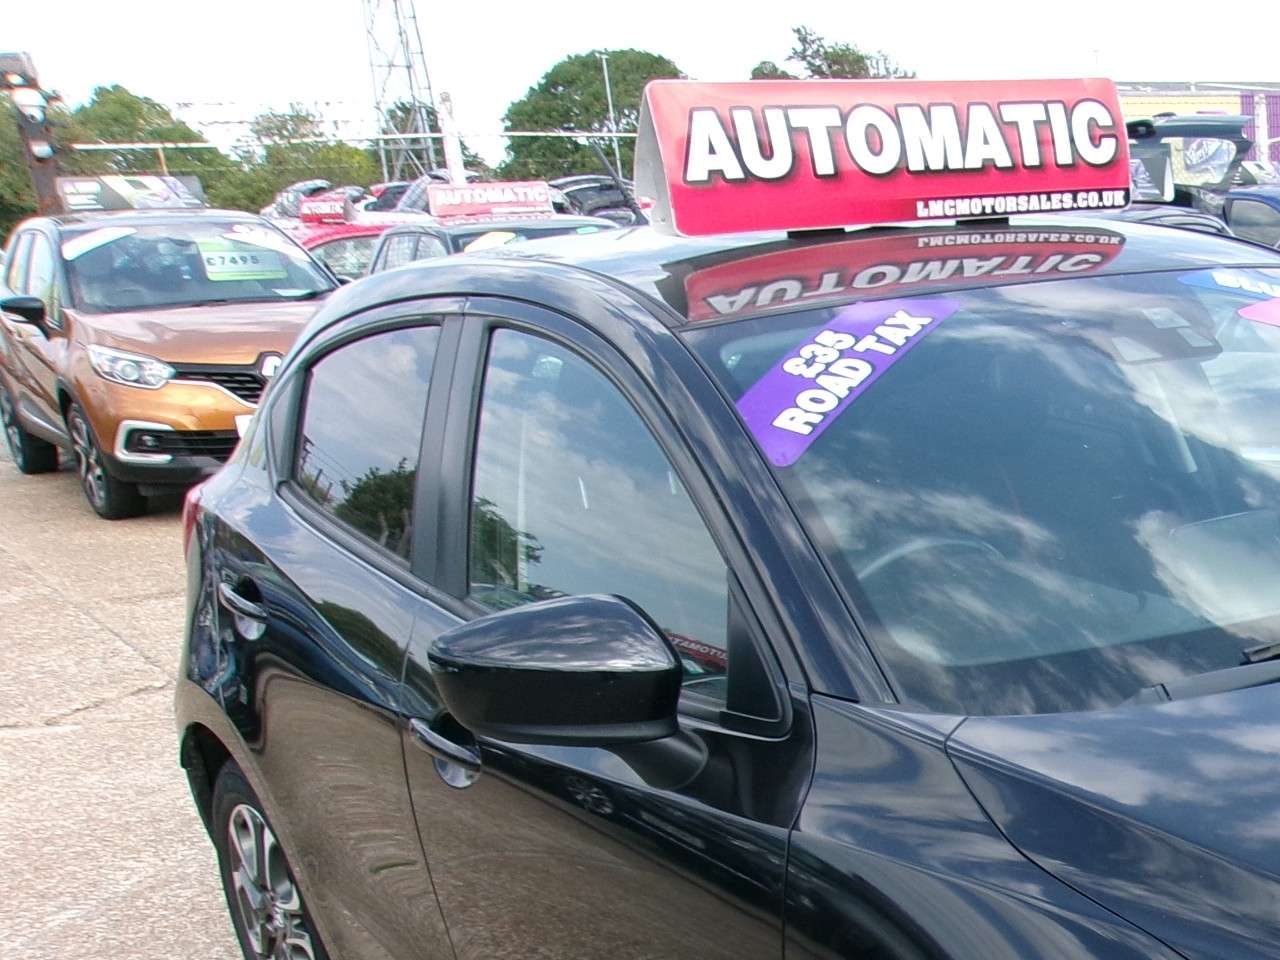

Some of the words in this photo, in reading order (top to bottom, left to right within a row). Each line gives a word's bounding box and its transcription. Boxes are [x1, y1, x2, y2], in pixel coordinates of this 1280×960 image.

[686, 100, 1118, 183] AUTOMATIC
[435, 188, 548, 206] AUTOMATIC
[916, 190, 1126, 218] LMCMOTORSALES.CO.UK
[772, 358, 873, 436] ROAD
[853, 310, 934, 355] TAX
[783, 330, 856, 379] £35
